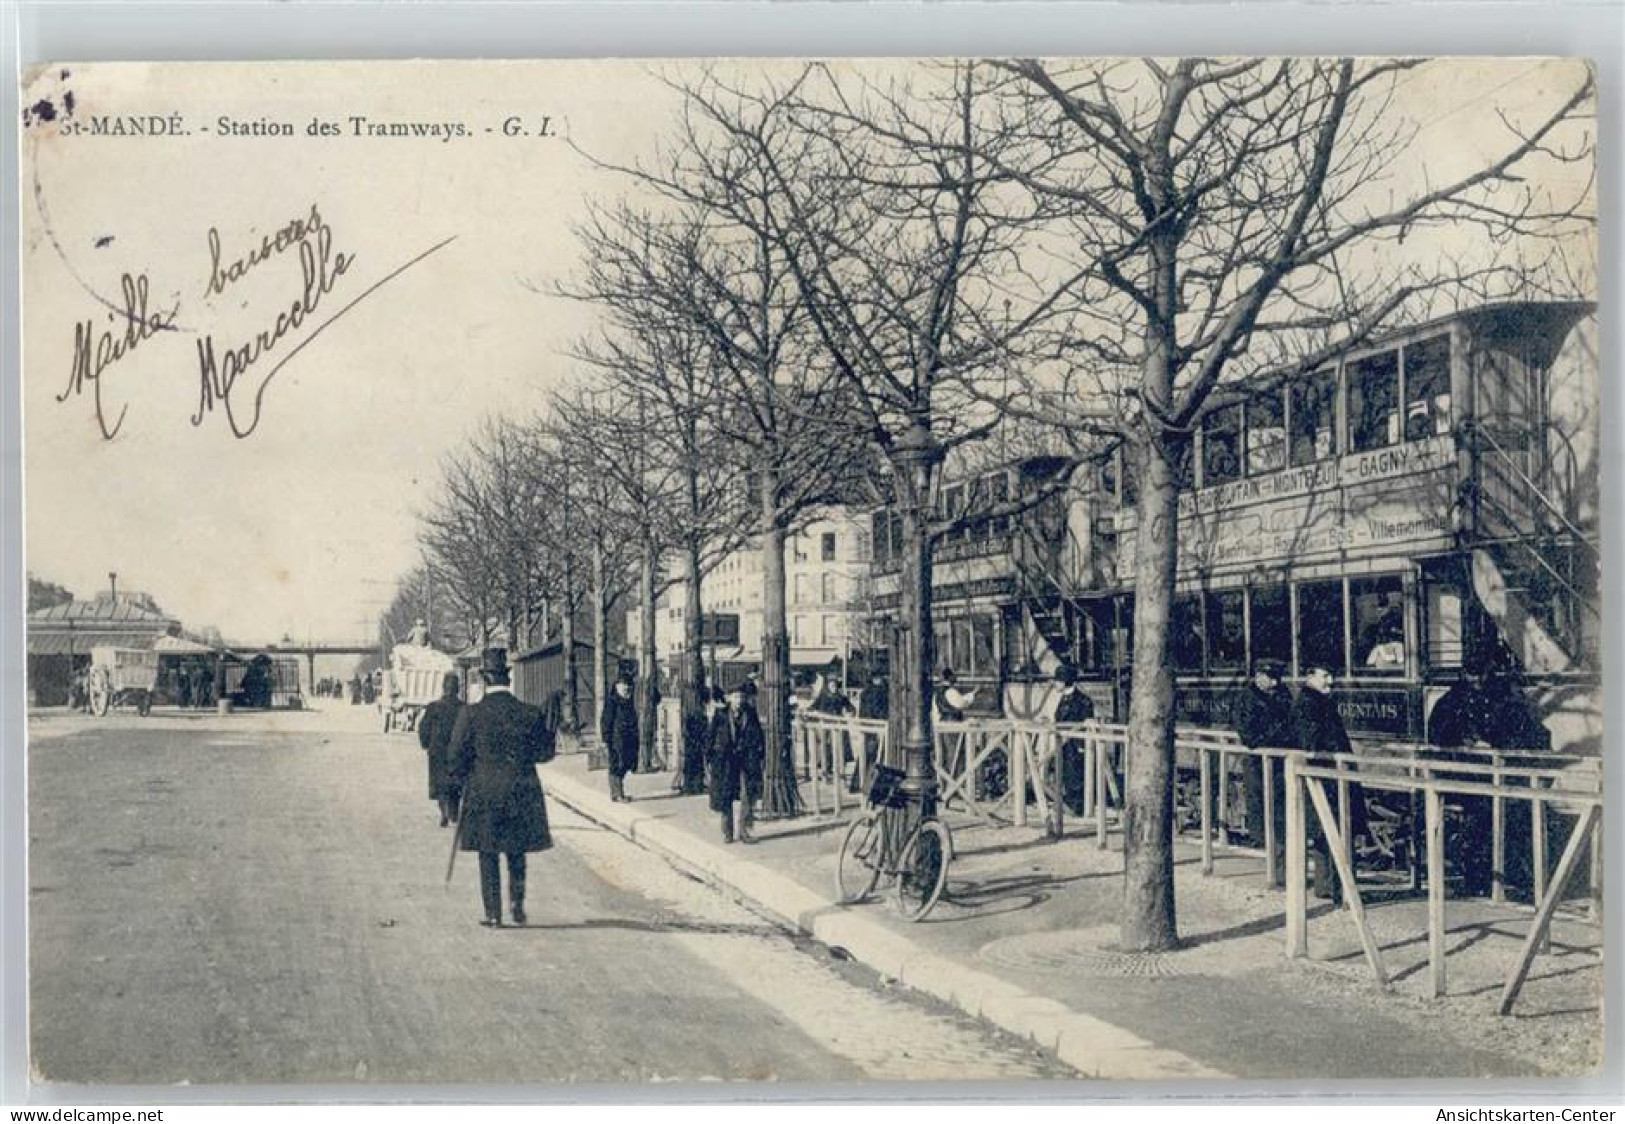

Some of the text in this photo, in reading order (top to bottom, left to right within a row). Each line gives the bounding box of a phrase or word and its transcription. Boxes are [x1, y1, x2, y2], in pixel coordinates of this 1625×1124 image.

[217, 116, 295, 136] Station
[306, 117, 341, 137] des
[348, 116, 473, 143] Tramways.
[502, 116, 529, 137] G.
[538, 116, 557, 137] I.
[191, 224, 357, 438] Marcelle
[1359, 448, 1410, 478] GAGNY
